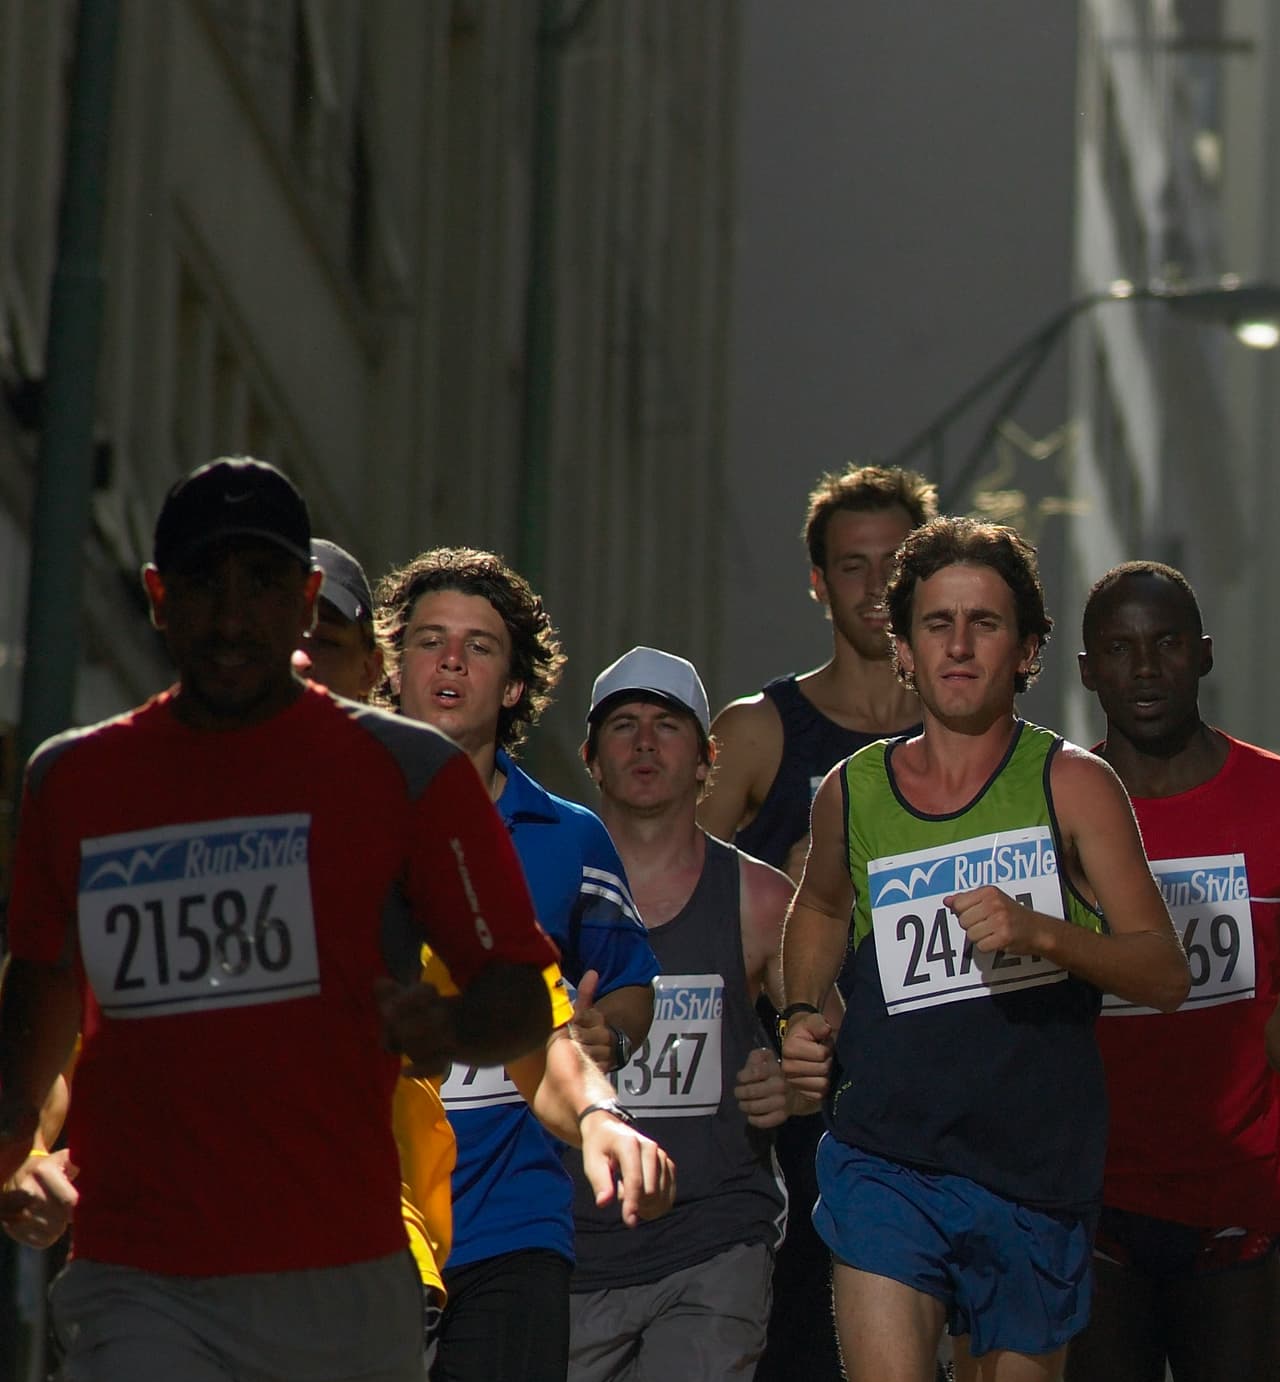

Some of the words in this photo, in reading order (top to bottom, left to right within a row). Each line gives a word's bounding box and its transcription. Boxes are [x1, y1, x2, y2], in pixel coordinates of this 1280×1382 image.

[184, 827, 308, 879] RunStyle
[954, 839, 1057, 891] RunStyle
[105, 884, 292, 991] 21586
[655, 987, 723, 1020] nStyle
